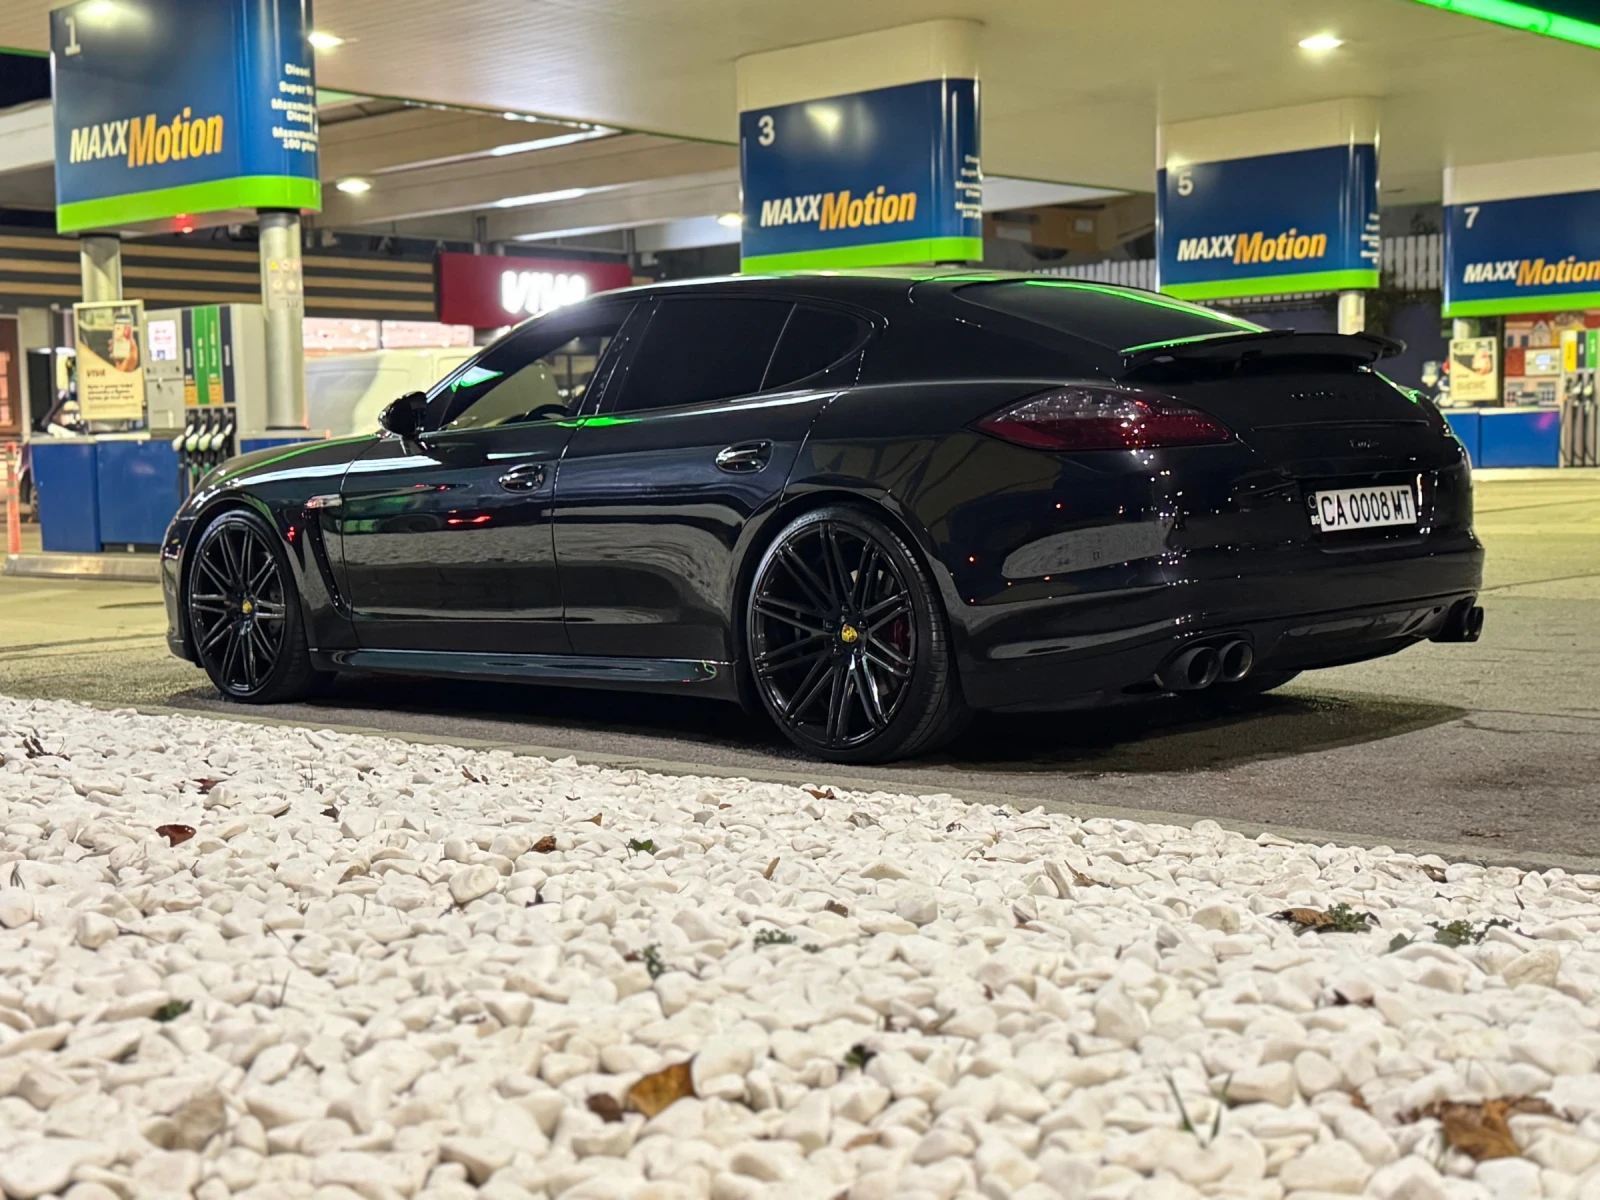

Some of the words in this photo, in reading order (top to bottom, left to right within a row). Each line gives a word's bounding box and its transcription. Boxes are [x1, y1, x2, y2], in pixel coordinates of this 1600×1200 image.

[64, 17, 81, 56] 1
[758, 115, 775, 146] 3
[1178, 172, 1193, 196] 5
[1464, 207, 1480, 229] 7
[1321, 494, 1348, 526] CA
[1349, 491, 1391, 523] 0008
